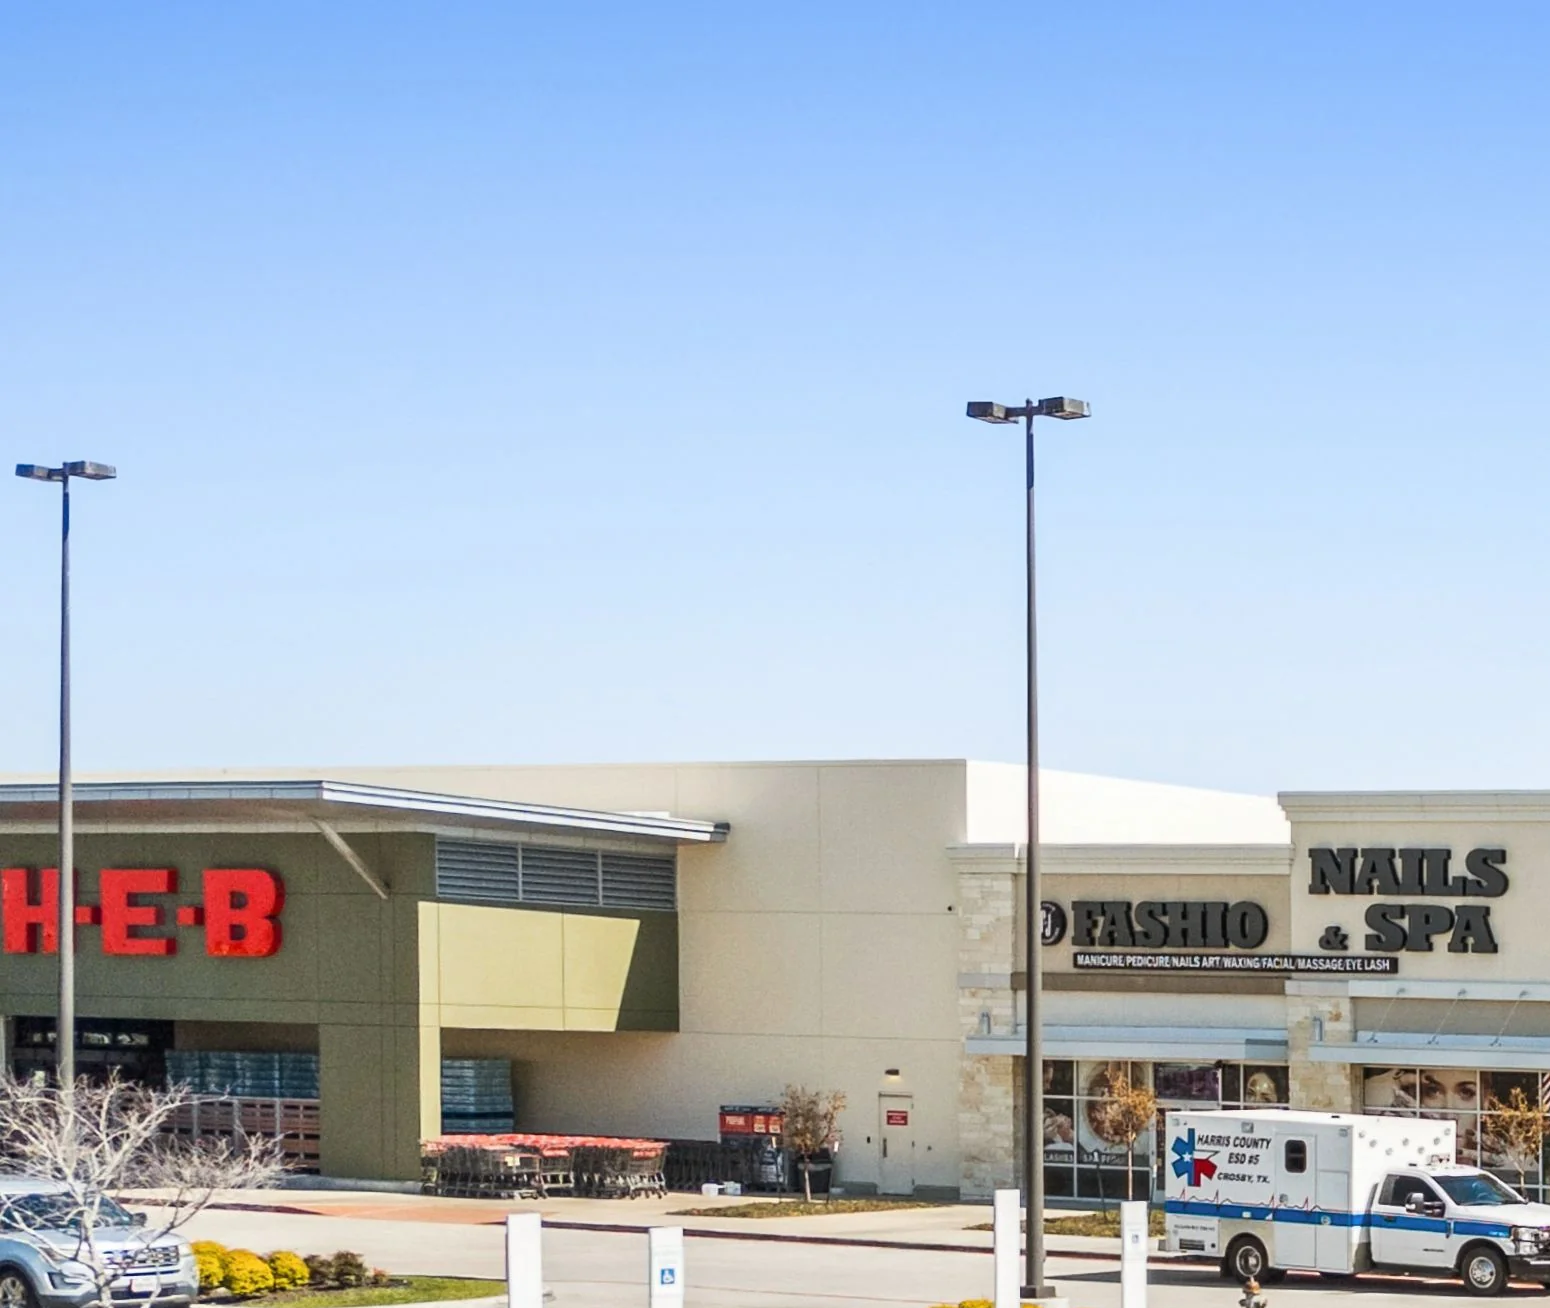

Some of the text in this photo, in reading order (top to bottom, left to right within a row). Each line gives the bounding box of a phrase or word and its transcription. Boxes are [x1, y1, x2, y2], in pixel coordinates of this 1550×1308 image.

[1308, 848, 1510, 898] NAILS
[1, 866, 286, 958] H-E-B
[1072, 901, 1269, 948] FASHIO
[1319, 904, 1499, 953] & SPA
[1364, 959, 1390, 971] LASH
[1197, 1134, 1272, 1149] HARRIS COUNTY
[1228, 1152, 1260, 1165] ESD #5
